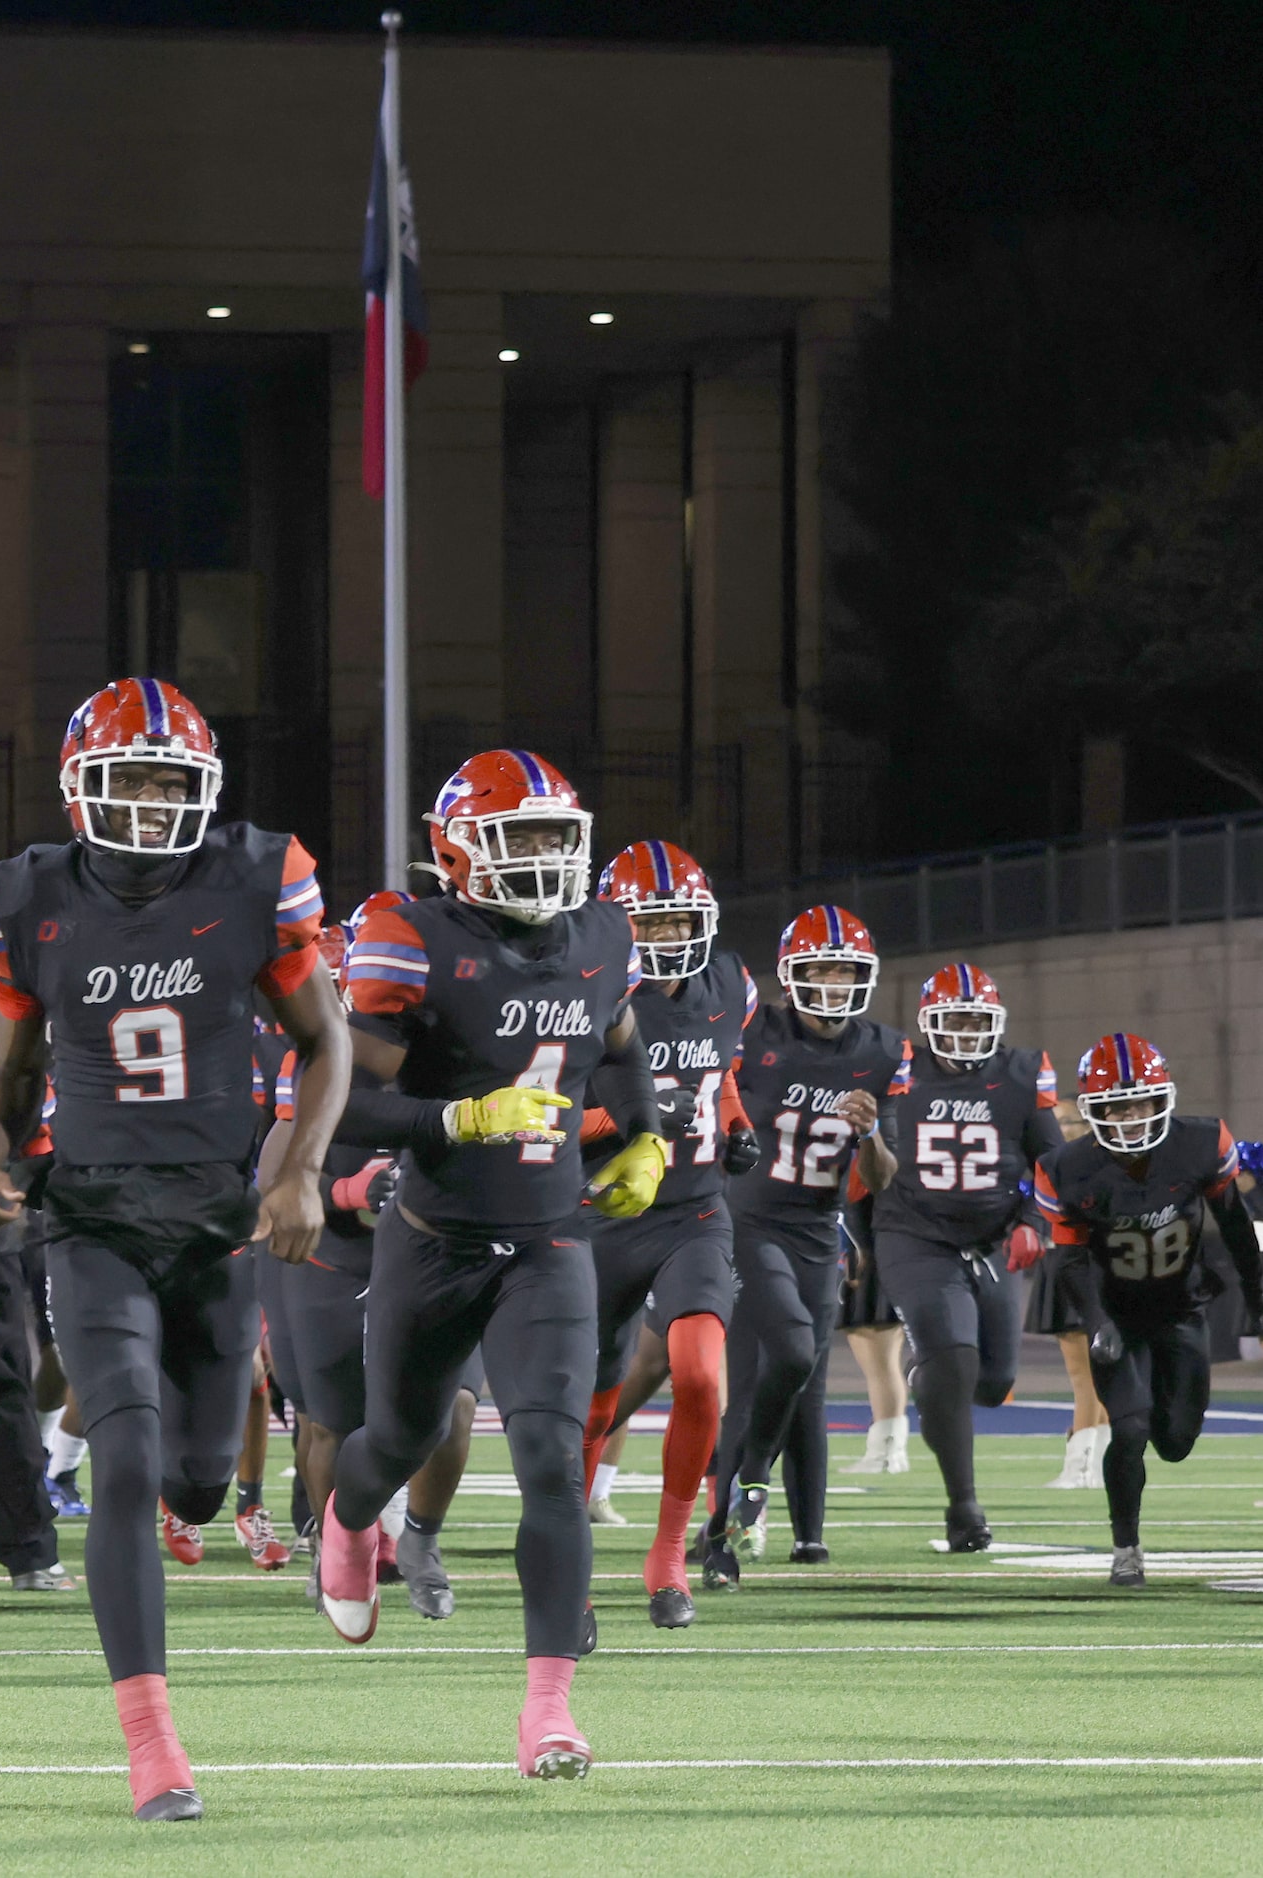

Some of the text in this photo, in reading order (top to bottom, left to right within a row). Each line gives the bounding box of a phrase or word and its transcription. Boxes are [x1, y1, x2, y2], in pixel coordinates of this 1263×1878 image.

[82, 957, 204, 1004] D'Ville
[496, 999, 592, 1037] D'Ville
[108, 1004, 188, 1102] 9
[648, 1038, 720, 1071] D'Ville
[511, 1042, 567, 1164] 4
[781, 1083, 851, 1115] D'Vill
[926, 1099, 992, 1122] D'Ville
[769, 1109, 853, 1188] 12
[916, 1122, 1000, 1191] 52
[1106, 1219, 1190, 1280] 38
